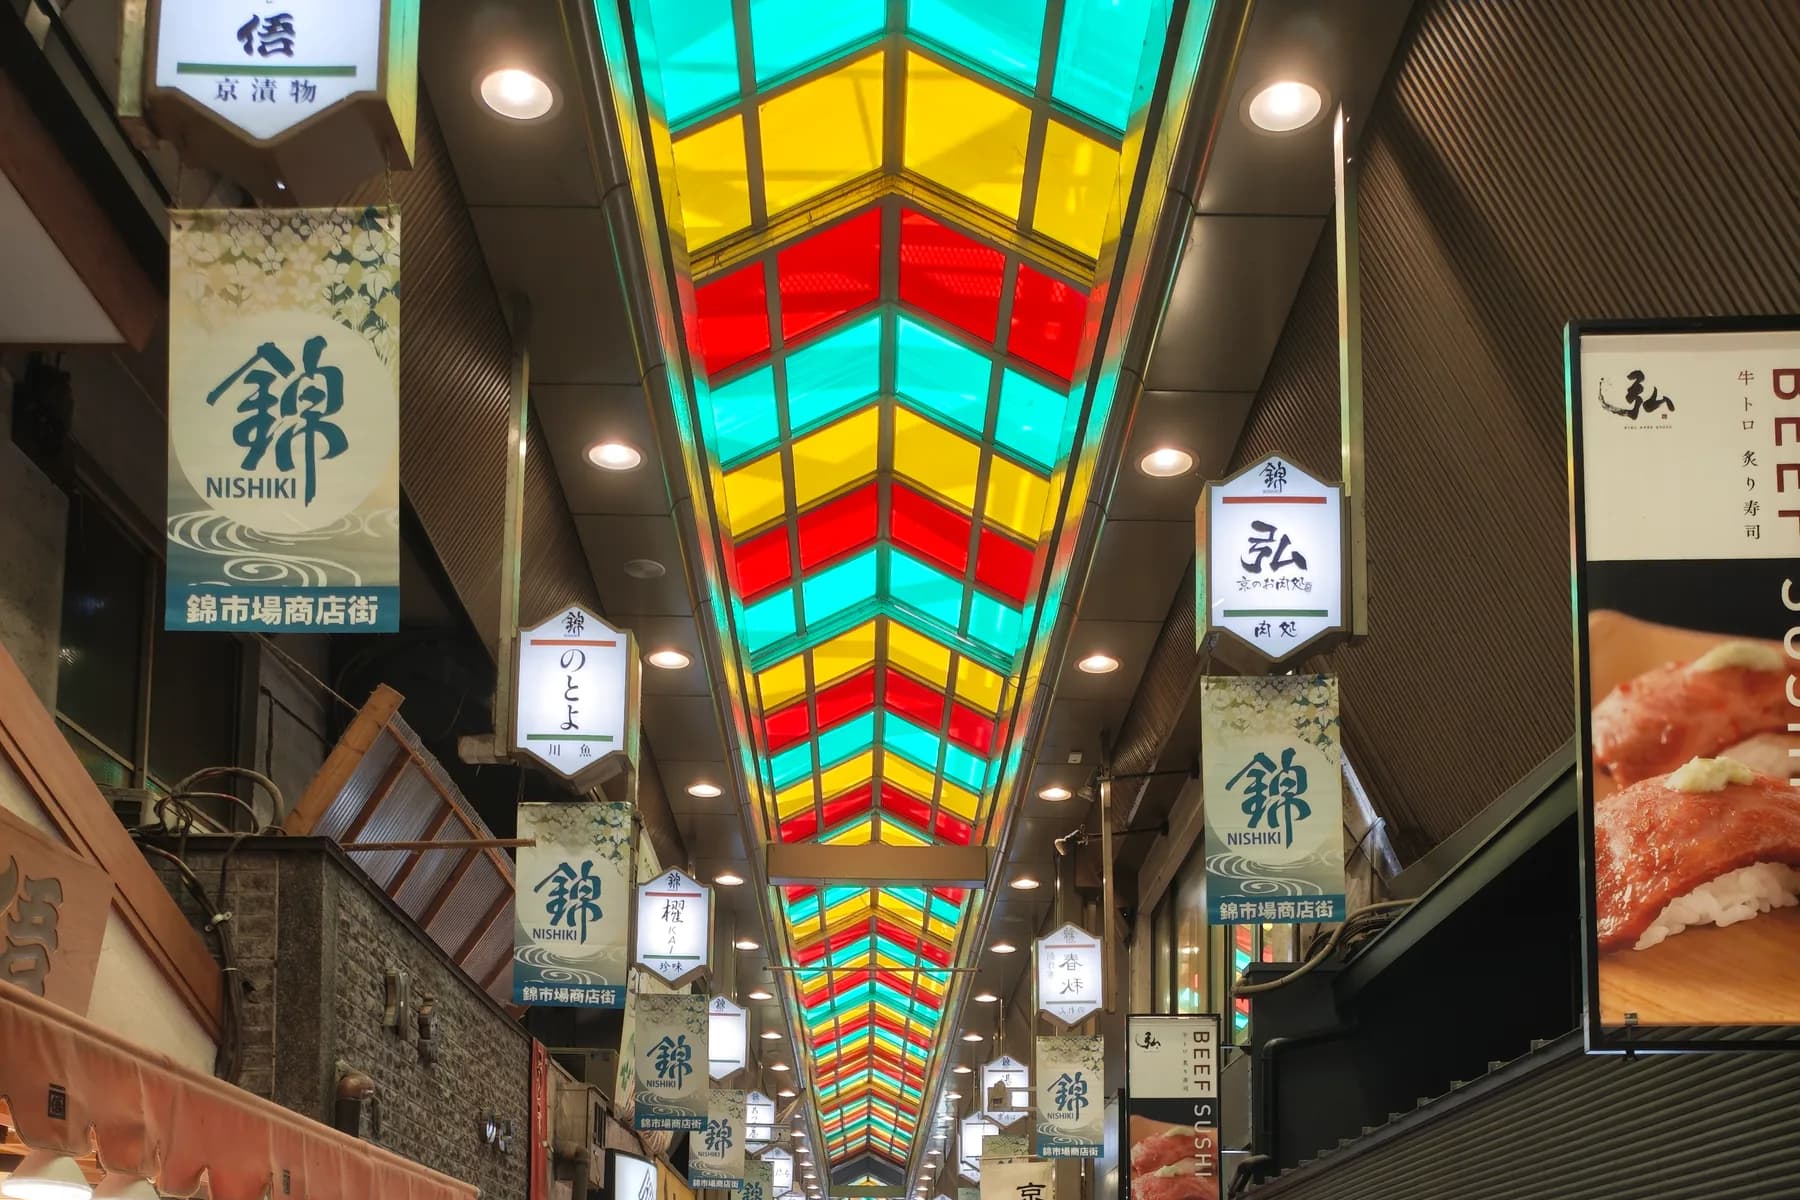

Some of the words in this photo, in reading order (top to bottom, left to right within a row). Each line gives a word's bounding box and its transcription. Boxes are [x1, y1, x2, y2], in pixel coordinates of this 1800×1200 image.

[215, 78, 317, 104] 京漬物
[1738, 369, 1755, 430] 牛トロ
[206, 335, 349, 507] 錦
[206, 477, 297, 499] NISHIKI
[1259, 461, 1287, 493] 錦
[1742, 449, 1760, 541] 炙り寿司
[1241, 520, 1307, 574] 弘
[187, 594, 378, 625] 錦市場商店街
[561, 611, 584, 637] 錦
[1254, 620, 1297, 638] 肉処
[558, 648, 586, 731] のとよ
[548, 743, 592, 758] 川魚
[1226, 748, 1312, 848] 錦
[1228, 833, 1281, 846] NISHIKI
[534, 860, 603, 944] 錦
[1220, 901, 1334, 920] 錦市場商店街
[532, 928, 577, 941] NISHIKI
[523, 985, 615, 1004] 錦市場商店街
[647, 1035, 693, 1090] 錦
[1193, 1031, 1210, 1091] BEEF
[1048, 1072, 1089, 1122] 錦
[641, 1117, 702, 1129] 錦市場商店街
[705, 1118, 733, 1158] 錦
[1043, 1145, 1098, 1156] 錦市場商店街
[1194, 1105, 1212, 1176] SUSHI
